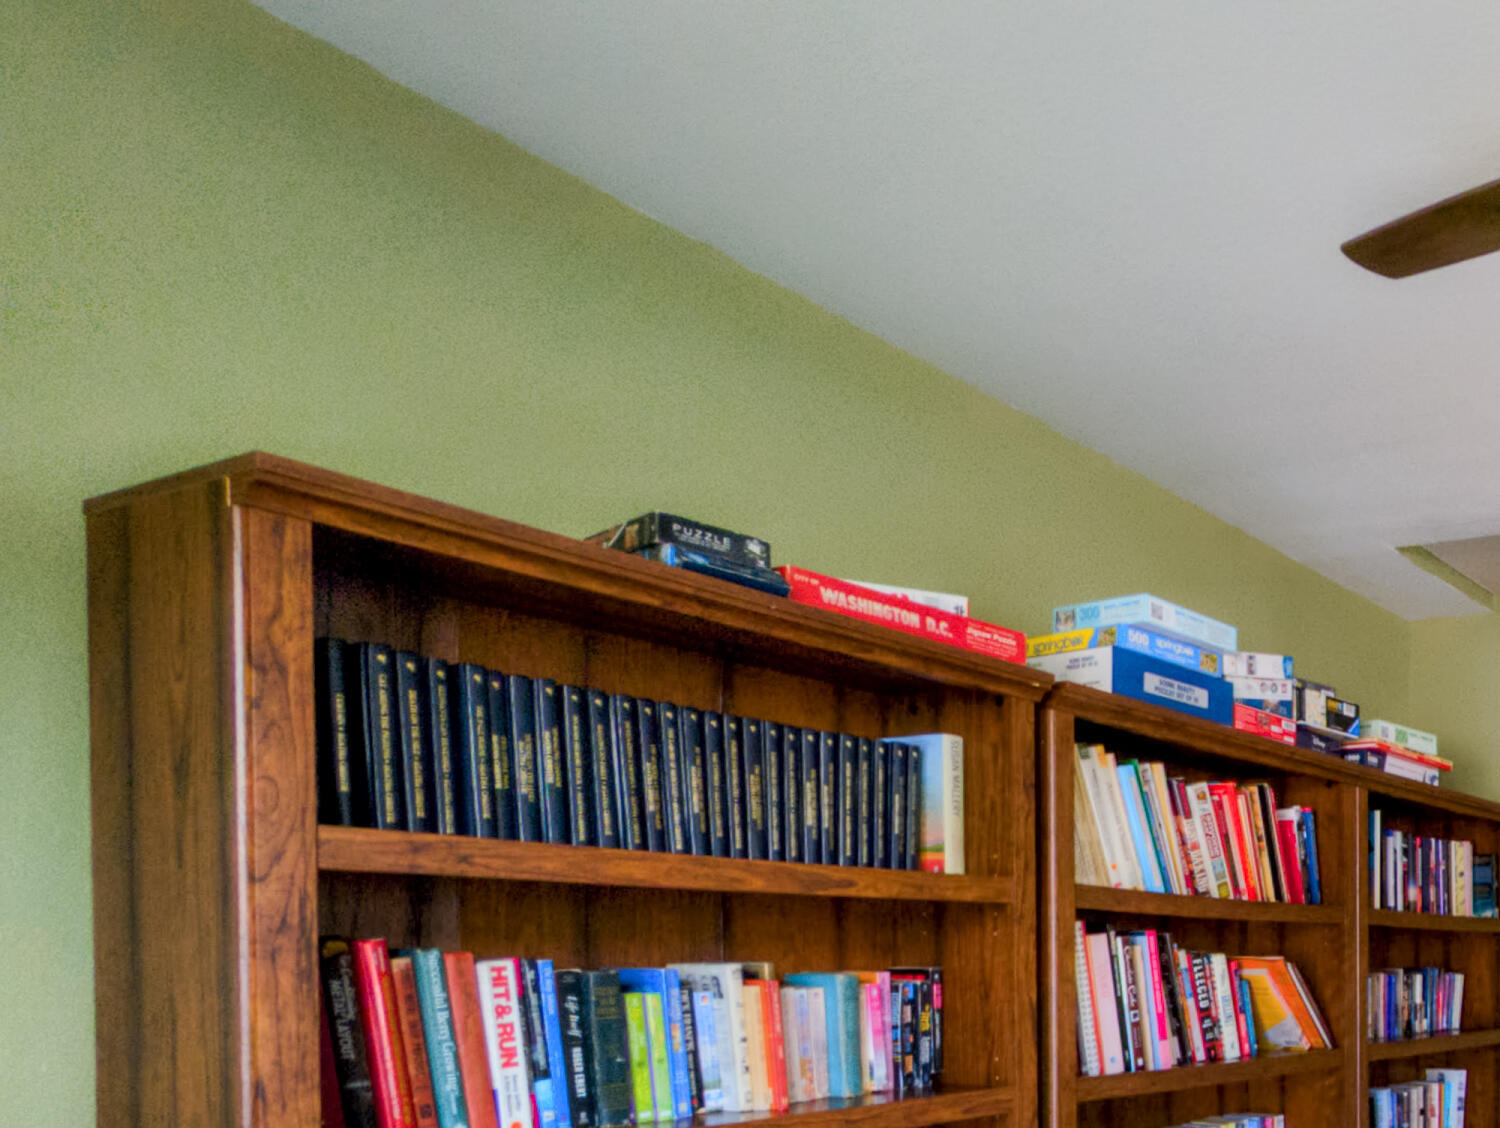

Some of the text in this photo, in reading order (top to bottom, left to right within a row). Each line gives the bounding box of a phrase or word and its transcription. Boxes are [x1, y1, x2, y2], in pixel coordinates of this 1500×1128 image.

[672, 522, 731, 546] PUZZLE
[819, 586, 954, 638] WASHINGTON D.C.
[1127, 629, 1150, 646] 500
[951, 739, 961, 817] SUSAN MALLERY
[1191, 958, 1210, 1009] FLEECED
[335, 1018, 356, 1062] LAYOUT
[427, 949, 461, 1092] Successful Berry Growing
[489, 965, 520, 1069] HIT & RUN
